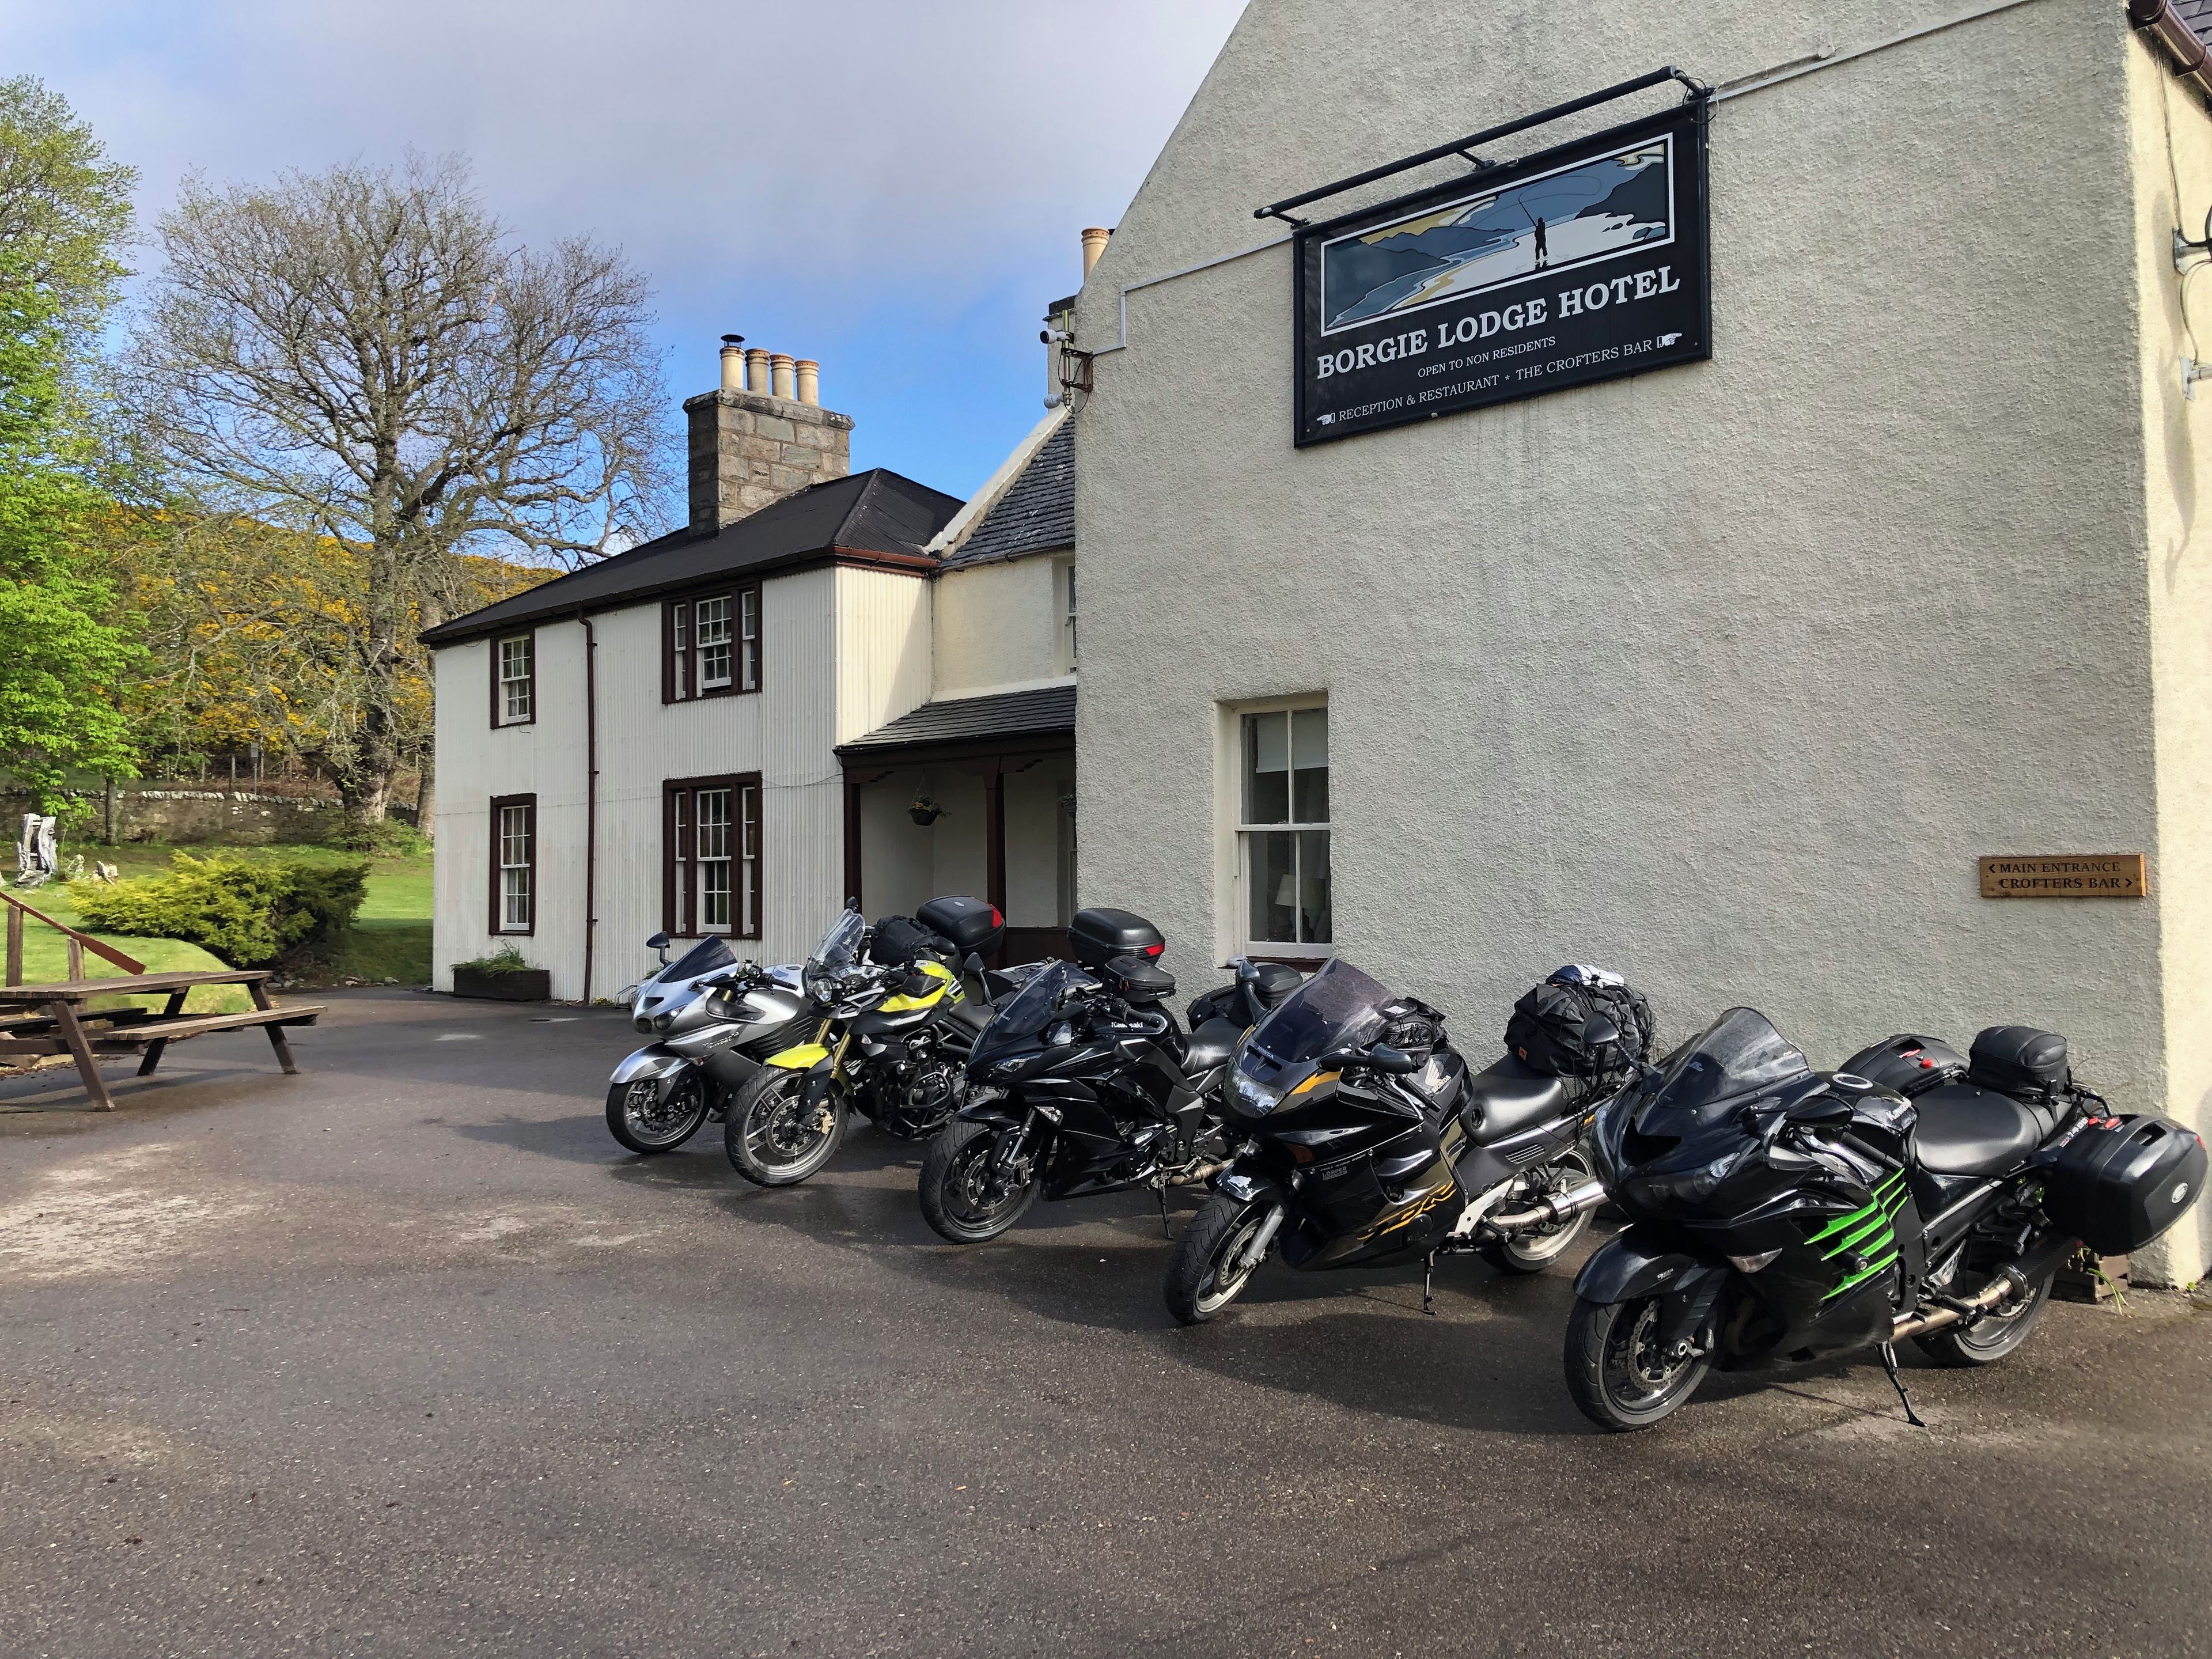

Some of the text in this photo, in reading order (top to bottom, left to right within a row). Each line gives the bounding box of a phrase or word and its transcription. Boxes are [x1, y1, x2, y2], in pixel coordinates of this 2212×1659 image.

[1317, 266, 1680, 379] BORGIE LODGE HOTEL
[1418, 336, 1556, 377] OPEN TO NON RESIDENTS
[1339, 339, 1652, 421] RECEPTION & RESTAURANT THE CROFTERS BAR
[2000, 862, 2121, 873] MAIN ENTRANCE
[1999, 877, 2121, 889] CROFTERS BAR
[1257, 1046, 1274, 1059] HONDA
[1431, 1074, 1452, 1094] HONDA
